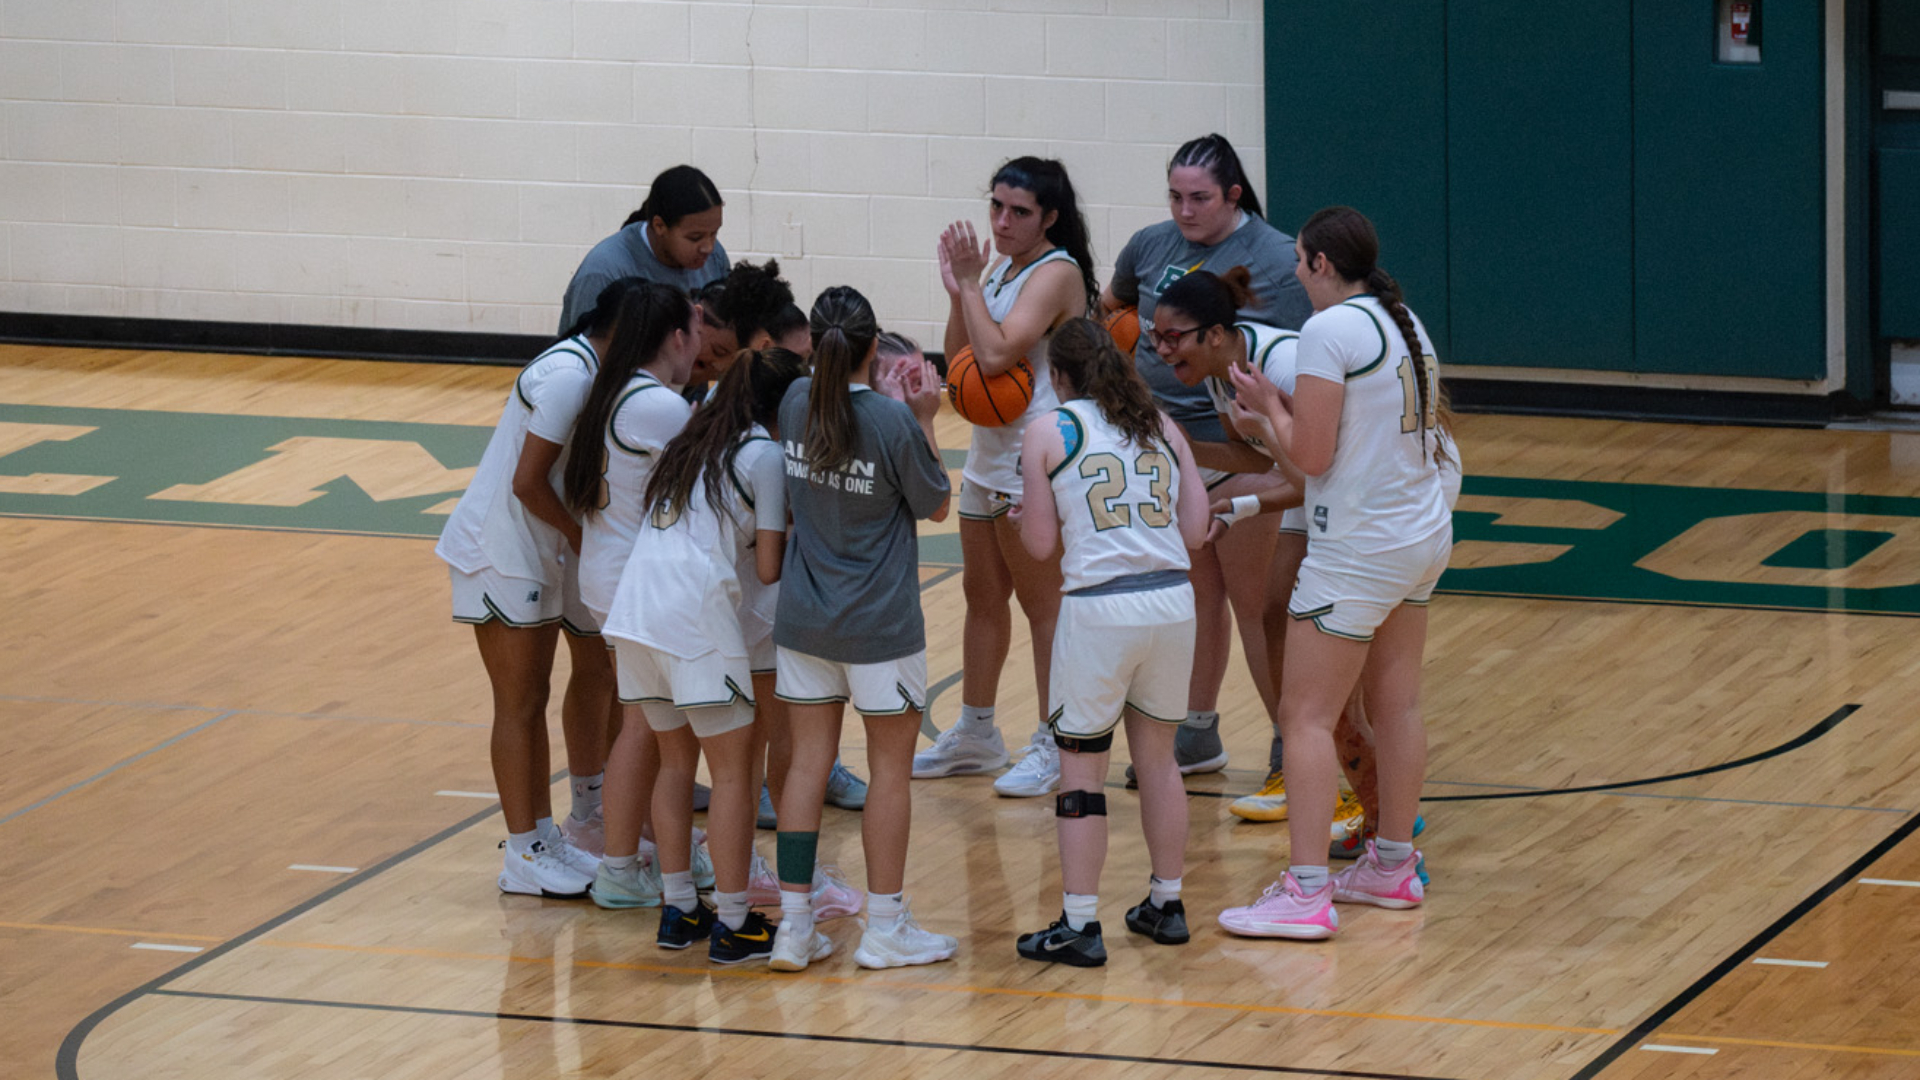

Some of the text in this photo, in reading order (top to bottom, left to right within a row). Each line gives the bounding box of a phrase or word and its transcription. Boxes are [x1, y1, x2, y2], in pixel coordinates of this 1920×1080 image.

[1396, 354, 1440, 434] 10
[828, 471, 841, 490] AS
[844, 476, 875, 495] ONE
[1078, 451, 1172, 532] 23
